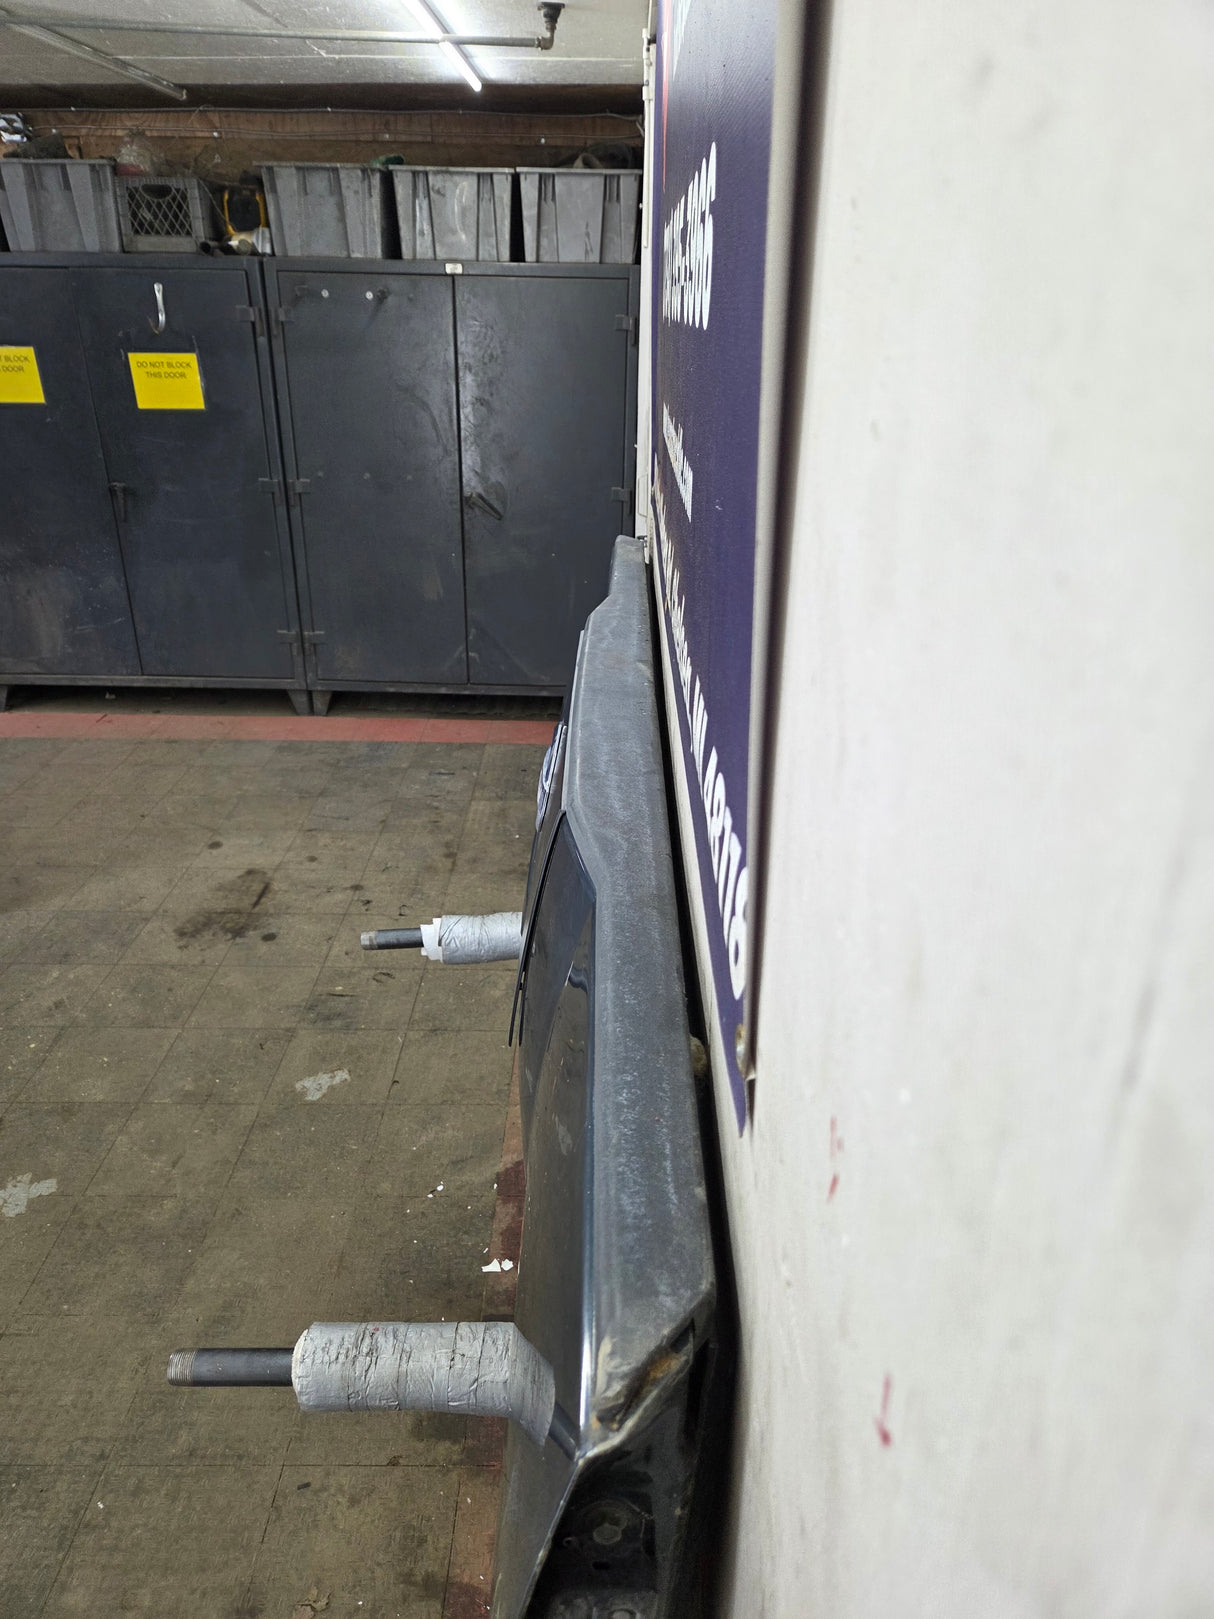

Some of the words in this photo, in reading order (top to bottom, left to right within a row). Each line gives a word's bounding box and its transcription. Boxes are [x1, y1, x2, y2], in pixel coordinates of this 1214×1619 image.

[4, 354, 30, 363] BLOCK
[2, 365, 24, 373] DOOR
[167, 361, 192, 369] BLOCK
[164, 371, 187, 379] DOOR
[693, 675, 708, 800] MI
[703, 746, 749, 1001] 48118
